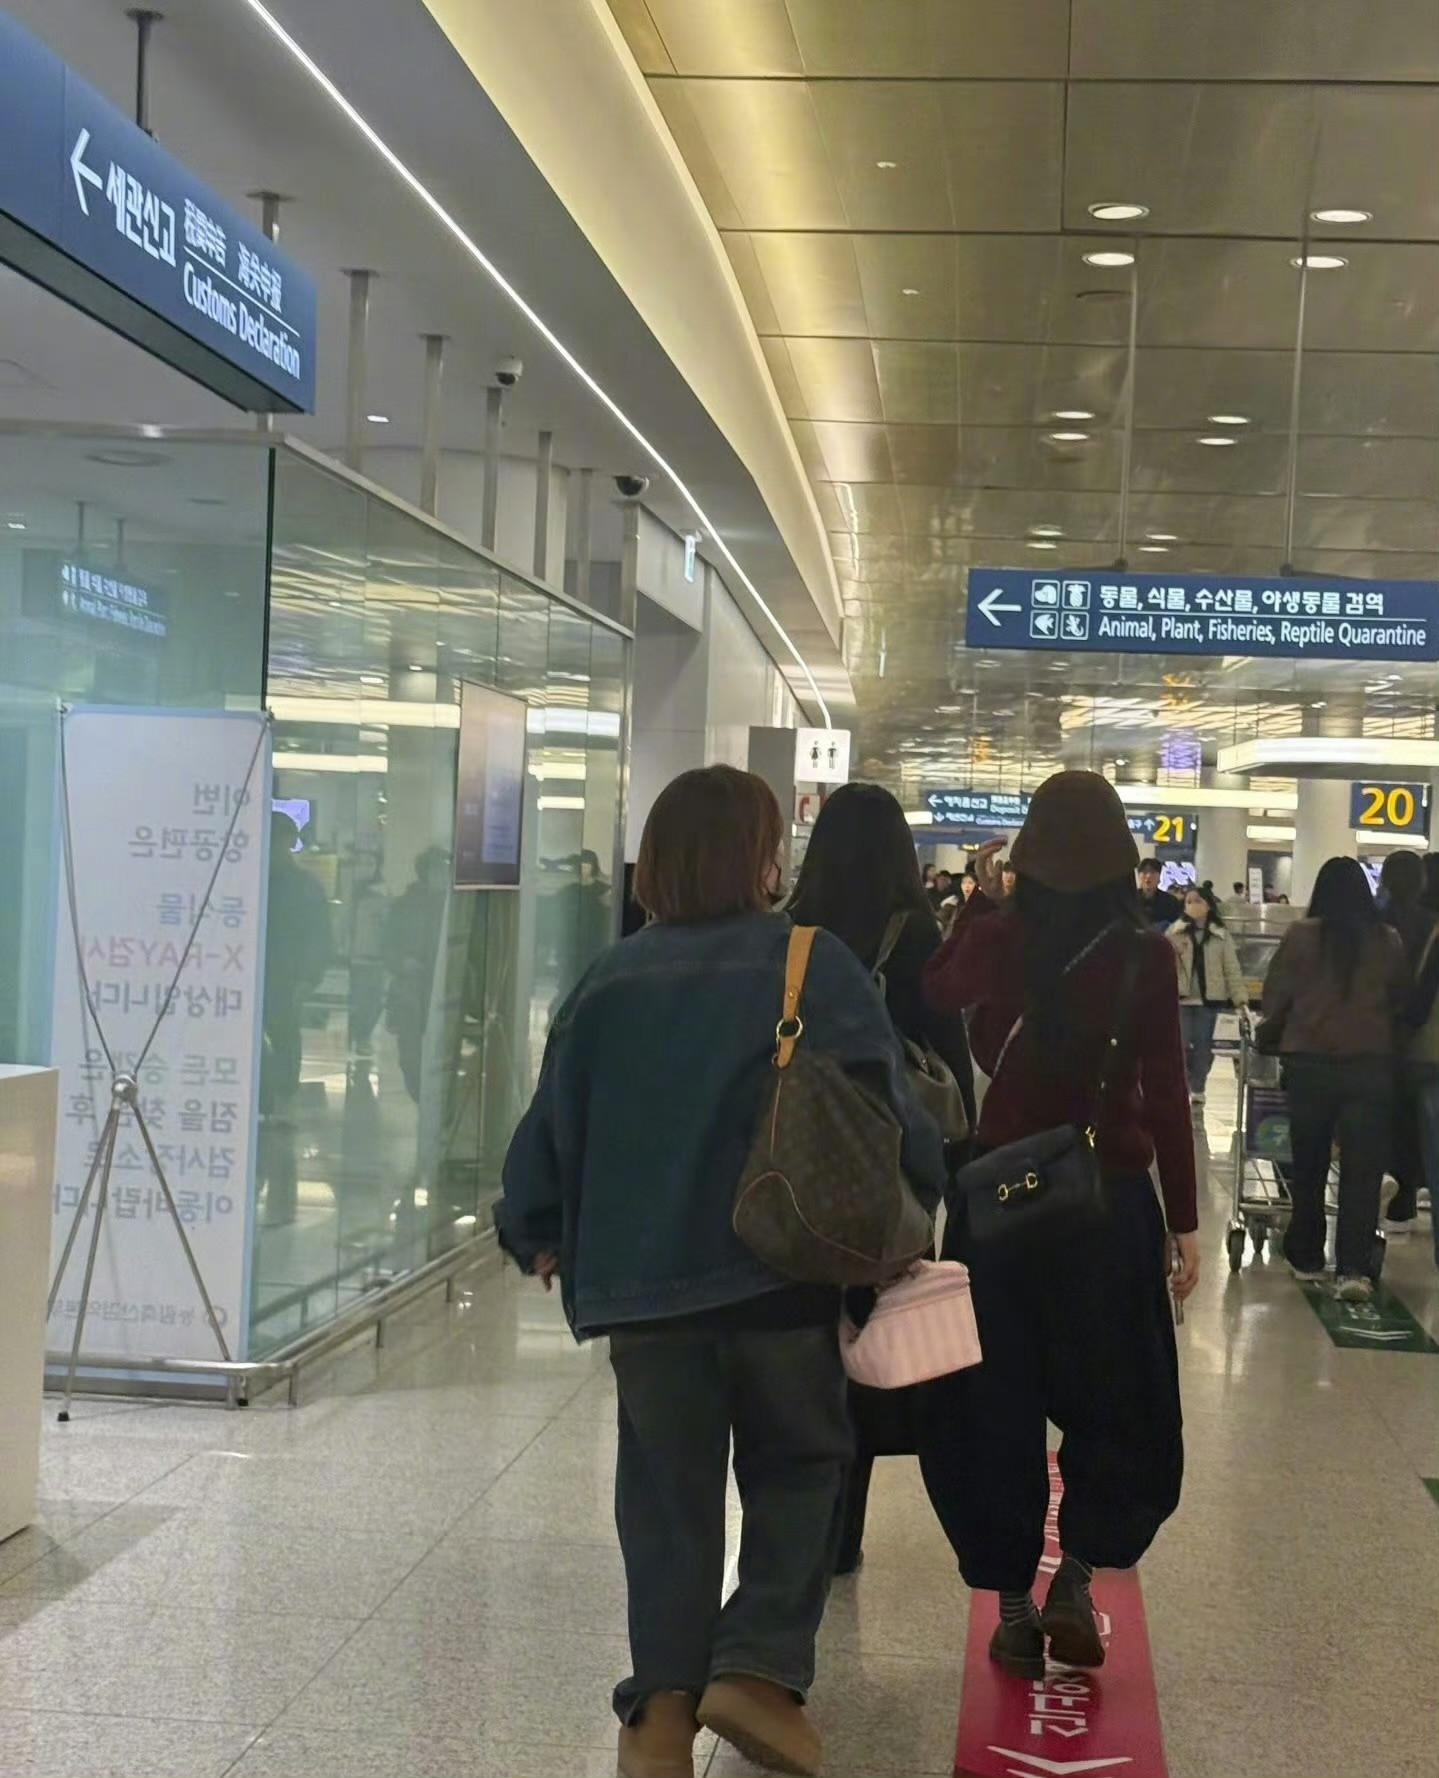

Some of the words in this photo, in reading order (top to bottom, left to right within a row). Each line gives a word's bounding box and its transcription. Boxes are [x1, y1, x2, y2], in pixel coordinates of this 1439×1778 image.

[106, 161, 176, 267] 세관신고
[184, 263, 236, 335] Customs
[239, 302, 300, 380] Declaration
[1099, 585, 1142, 611] 동물,
[1147, 587, 1190, 612] 식물,
[1195, 588, 1258, 614] 수산물,
[1262, 589, 1341, 615] 야생동물
[1345, 592, 1384, 615] 검역
[1098, 615, 1157, 642] Animal,
[1161, 617, 1202, 643] Plant,
[1208, 619, 1275, 645] Fisheries,
[1281, 621, 1334, 648] Reptile
[1338, 623, 1426, 646] Quarantine
[1359, 787, 1414, 826] 20
[1153, 814, 1184, 842] 21
